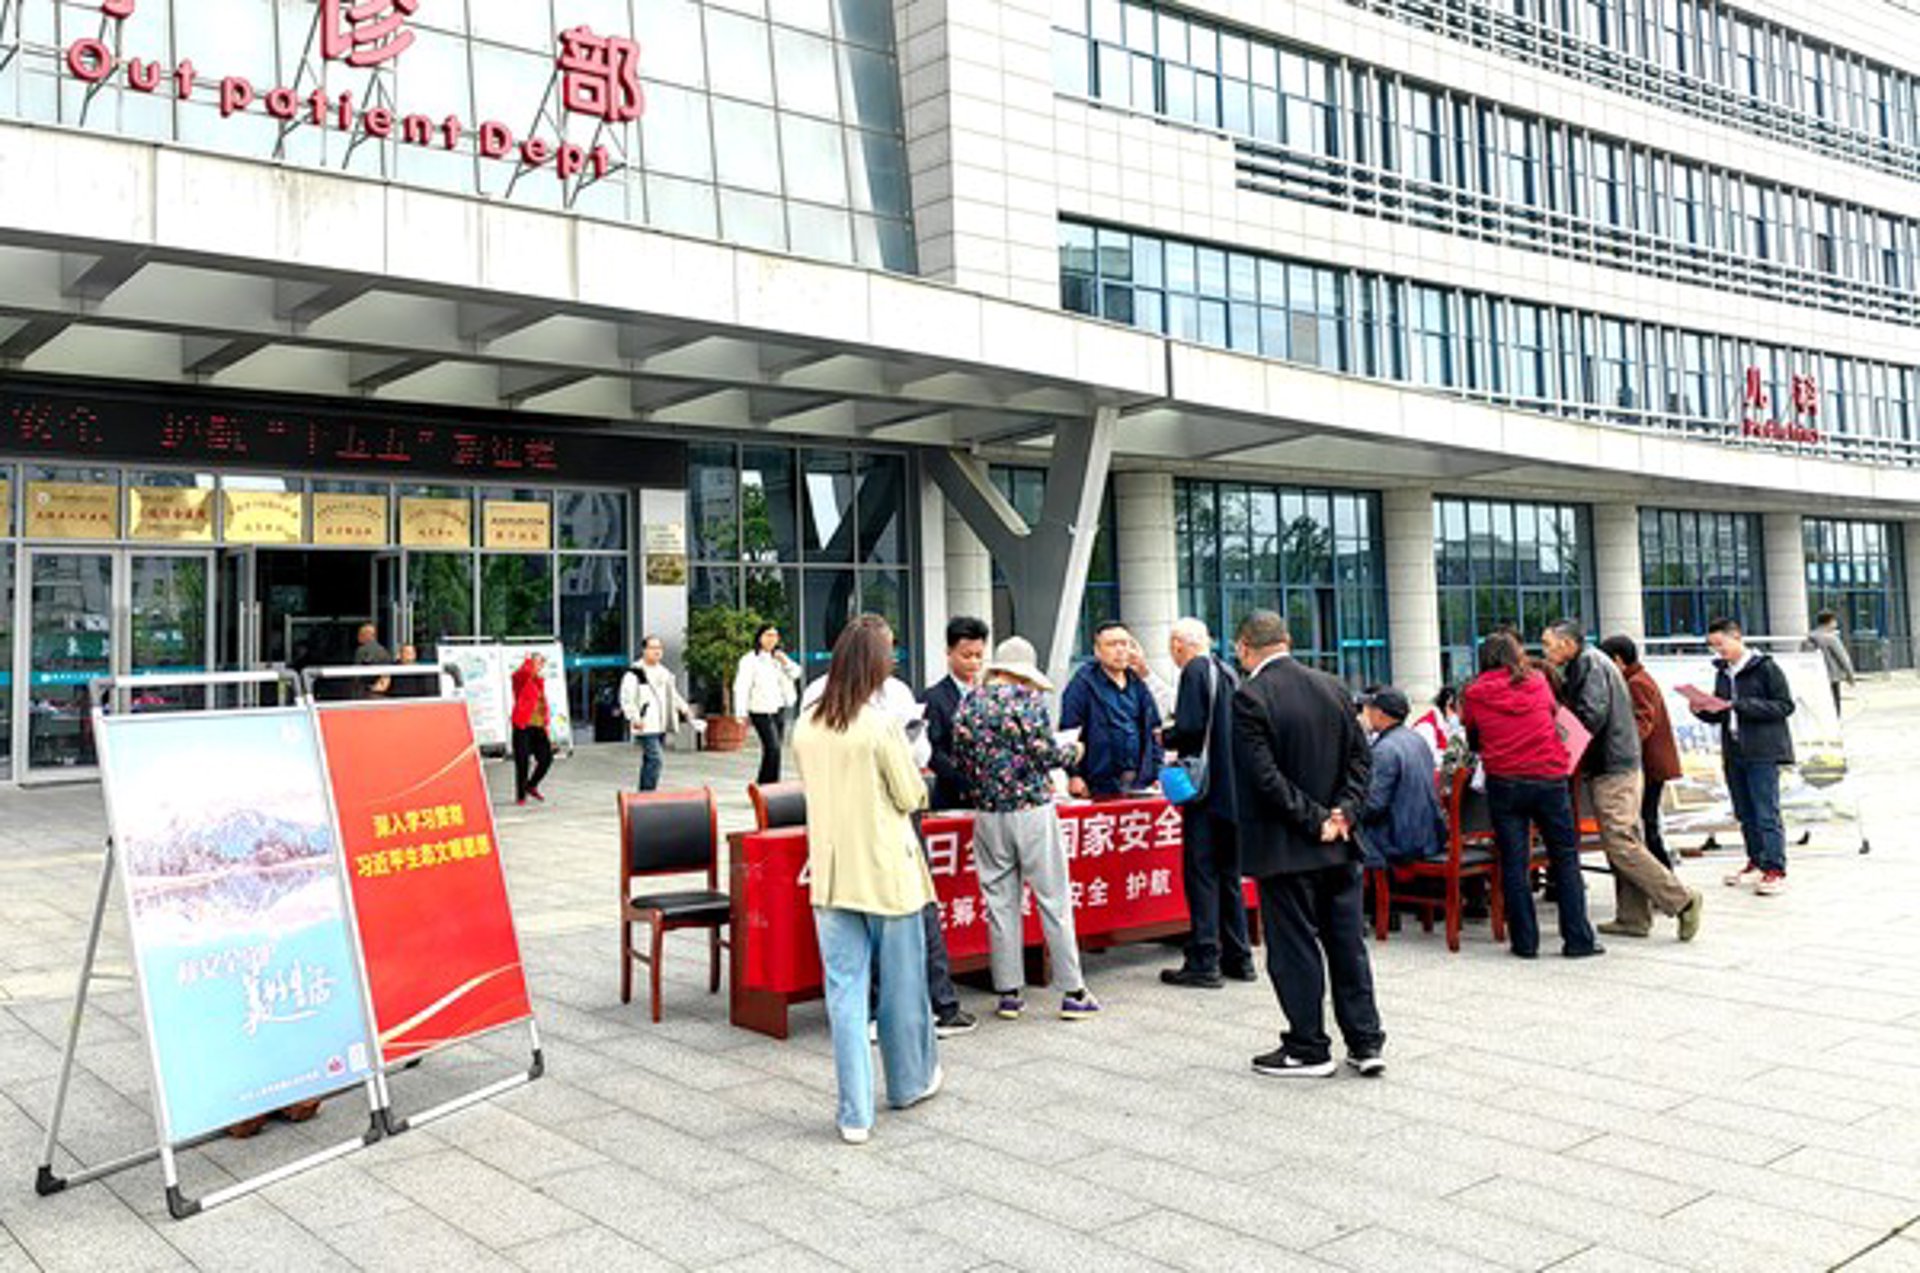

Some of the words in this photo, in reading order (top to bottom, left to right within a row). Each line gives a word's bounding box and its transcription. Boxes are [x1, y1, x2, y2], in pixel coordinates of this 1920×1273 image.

[102, 0, 641, 122] 诊部
[480, 120, 609, 179] Dept
[1126, 868, 1172, 900] 护航
